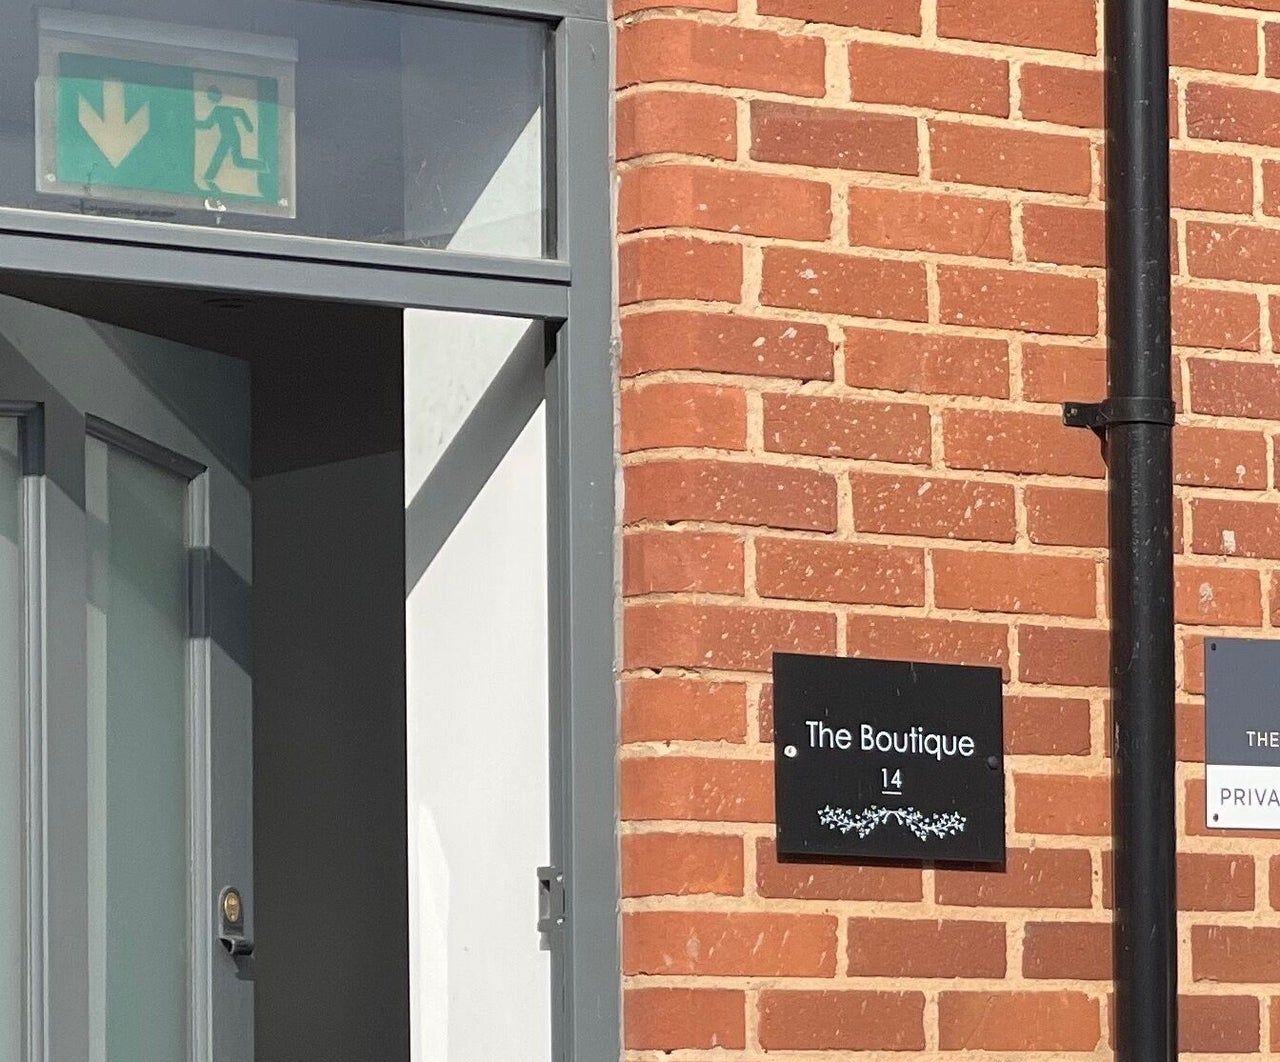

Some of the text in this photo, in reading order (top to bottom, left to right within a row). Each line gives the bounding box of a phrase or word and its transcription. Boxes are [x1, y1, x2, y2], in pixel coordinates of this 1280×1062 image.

[805, 721, 975, 761] The Boutique
[1246, 730, 1280, 748] THE
[881, 768, 903, 789] 14
